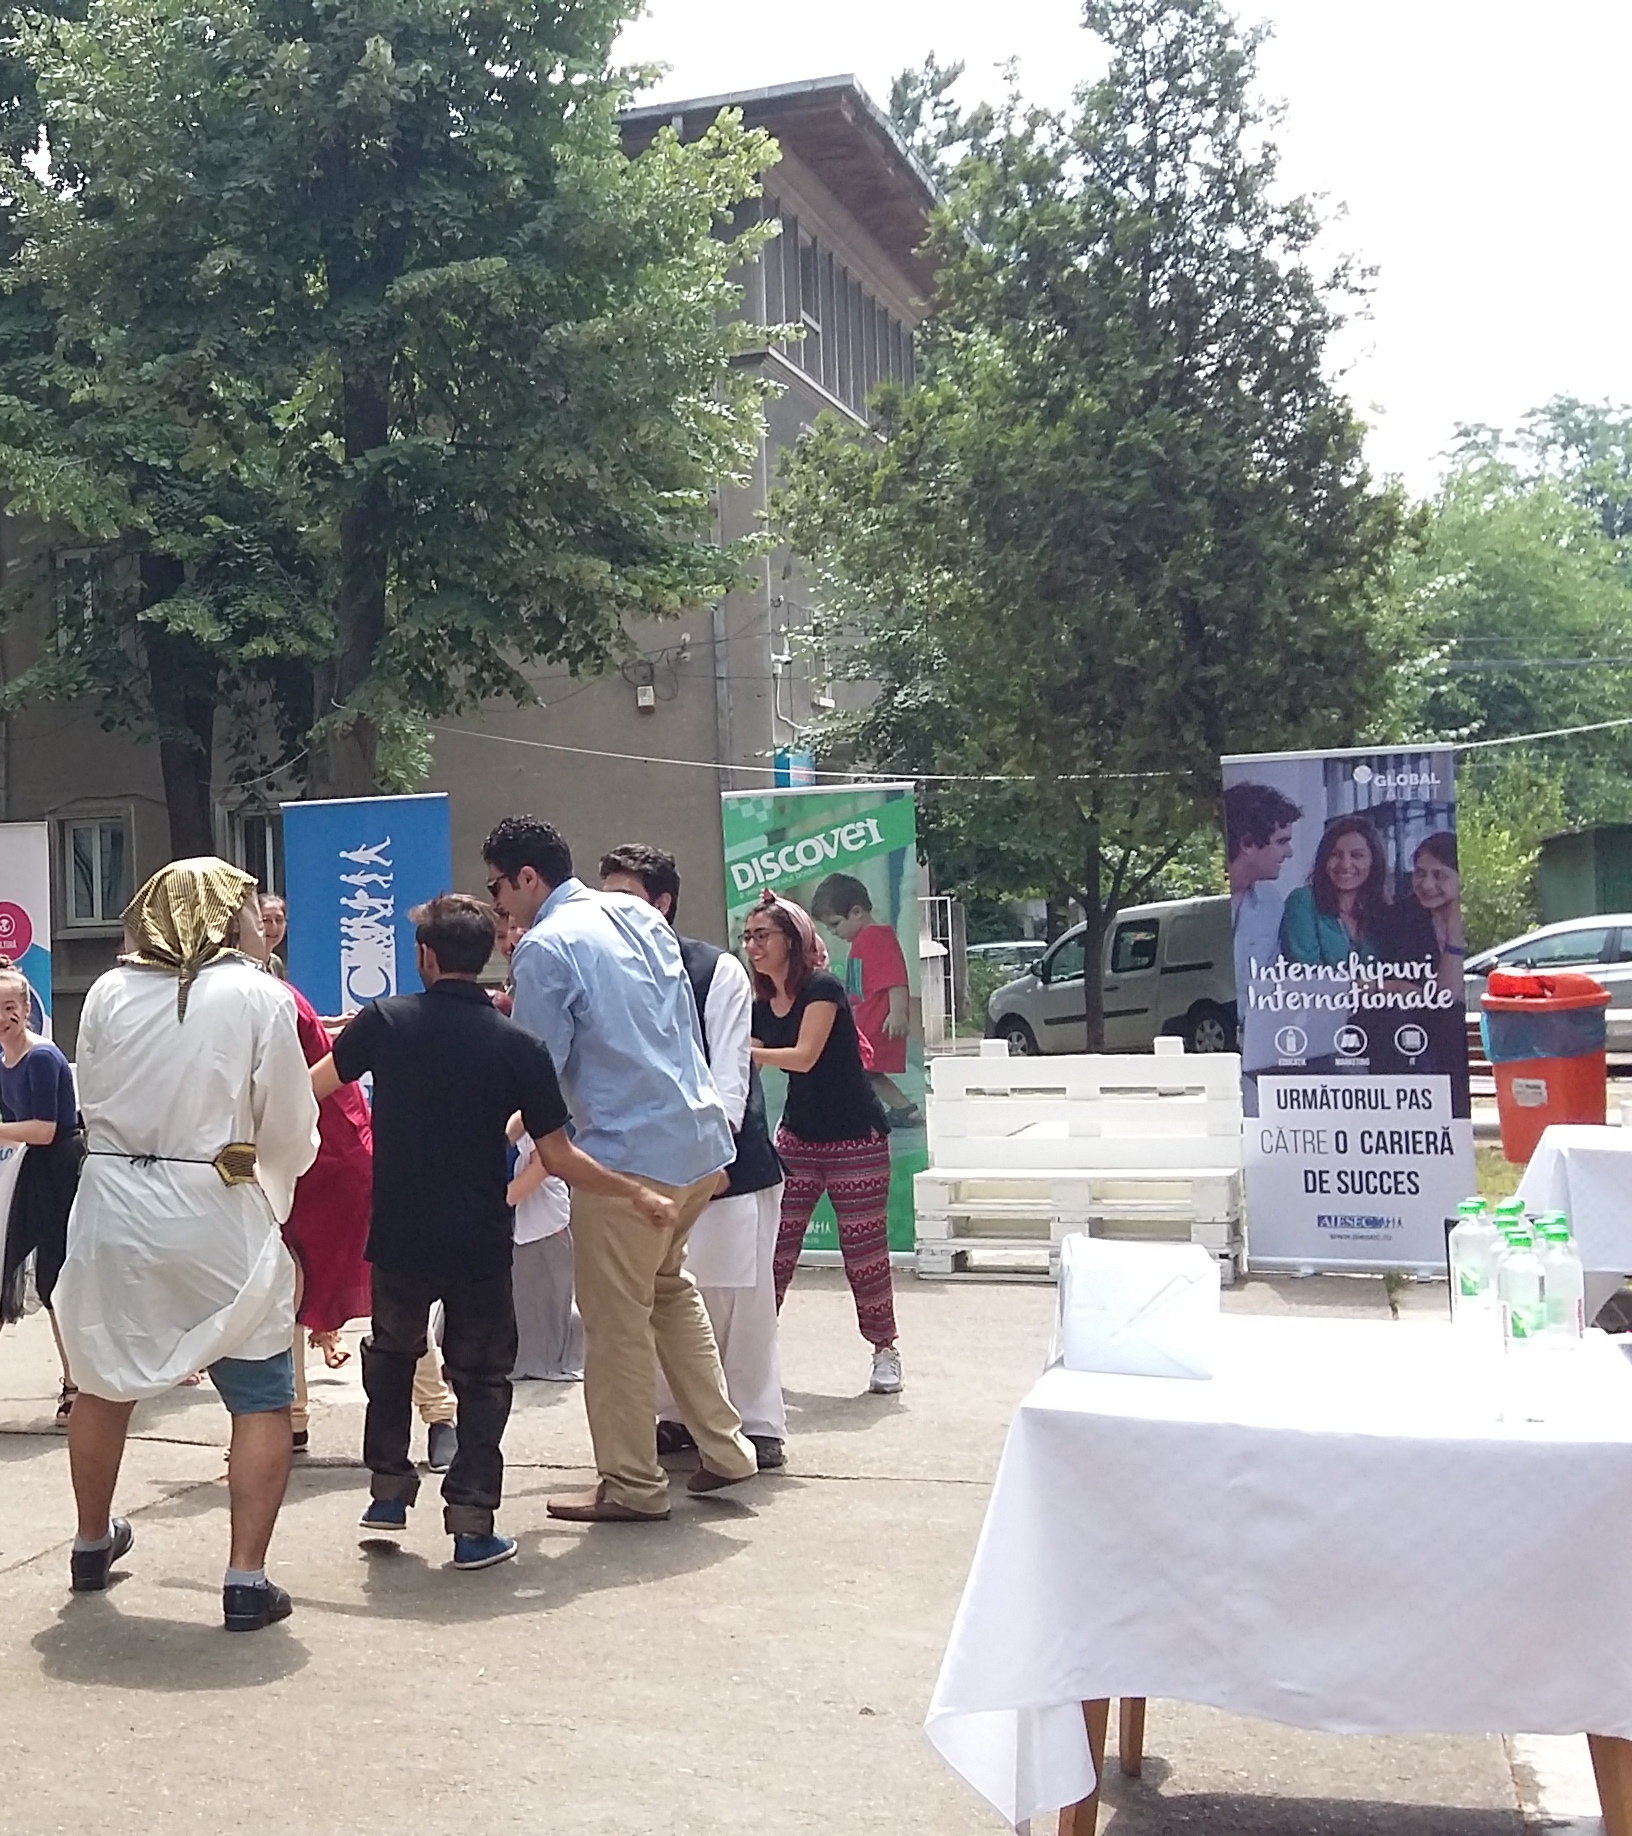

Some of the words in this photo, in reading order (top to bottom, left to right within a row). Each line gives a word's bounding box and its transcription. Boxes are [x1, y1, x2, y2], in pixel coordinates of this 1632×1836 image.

[1373, 772, 1442, 787] GLOBAL
[1249, 951, 1438, 990] Internshipuri
[1247, 979, 1454, 1014] Internaționale
[1276, 1084, 1391, 1110] URMĂTORUL
[1396, 1088, 1433, 1110] PAS
[1260, 1126, 1329, 1155] CĂTRE
[1334, 1130, 1348, 1155] O
[1360, 1126, 1455, 1155] CARIERĂ
[1304, 1169, 1331, 1194] DE
[1337, 1170, 1420, 1196] SUCCES
[1319, 1215, 1373, 1228] AIESEC
